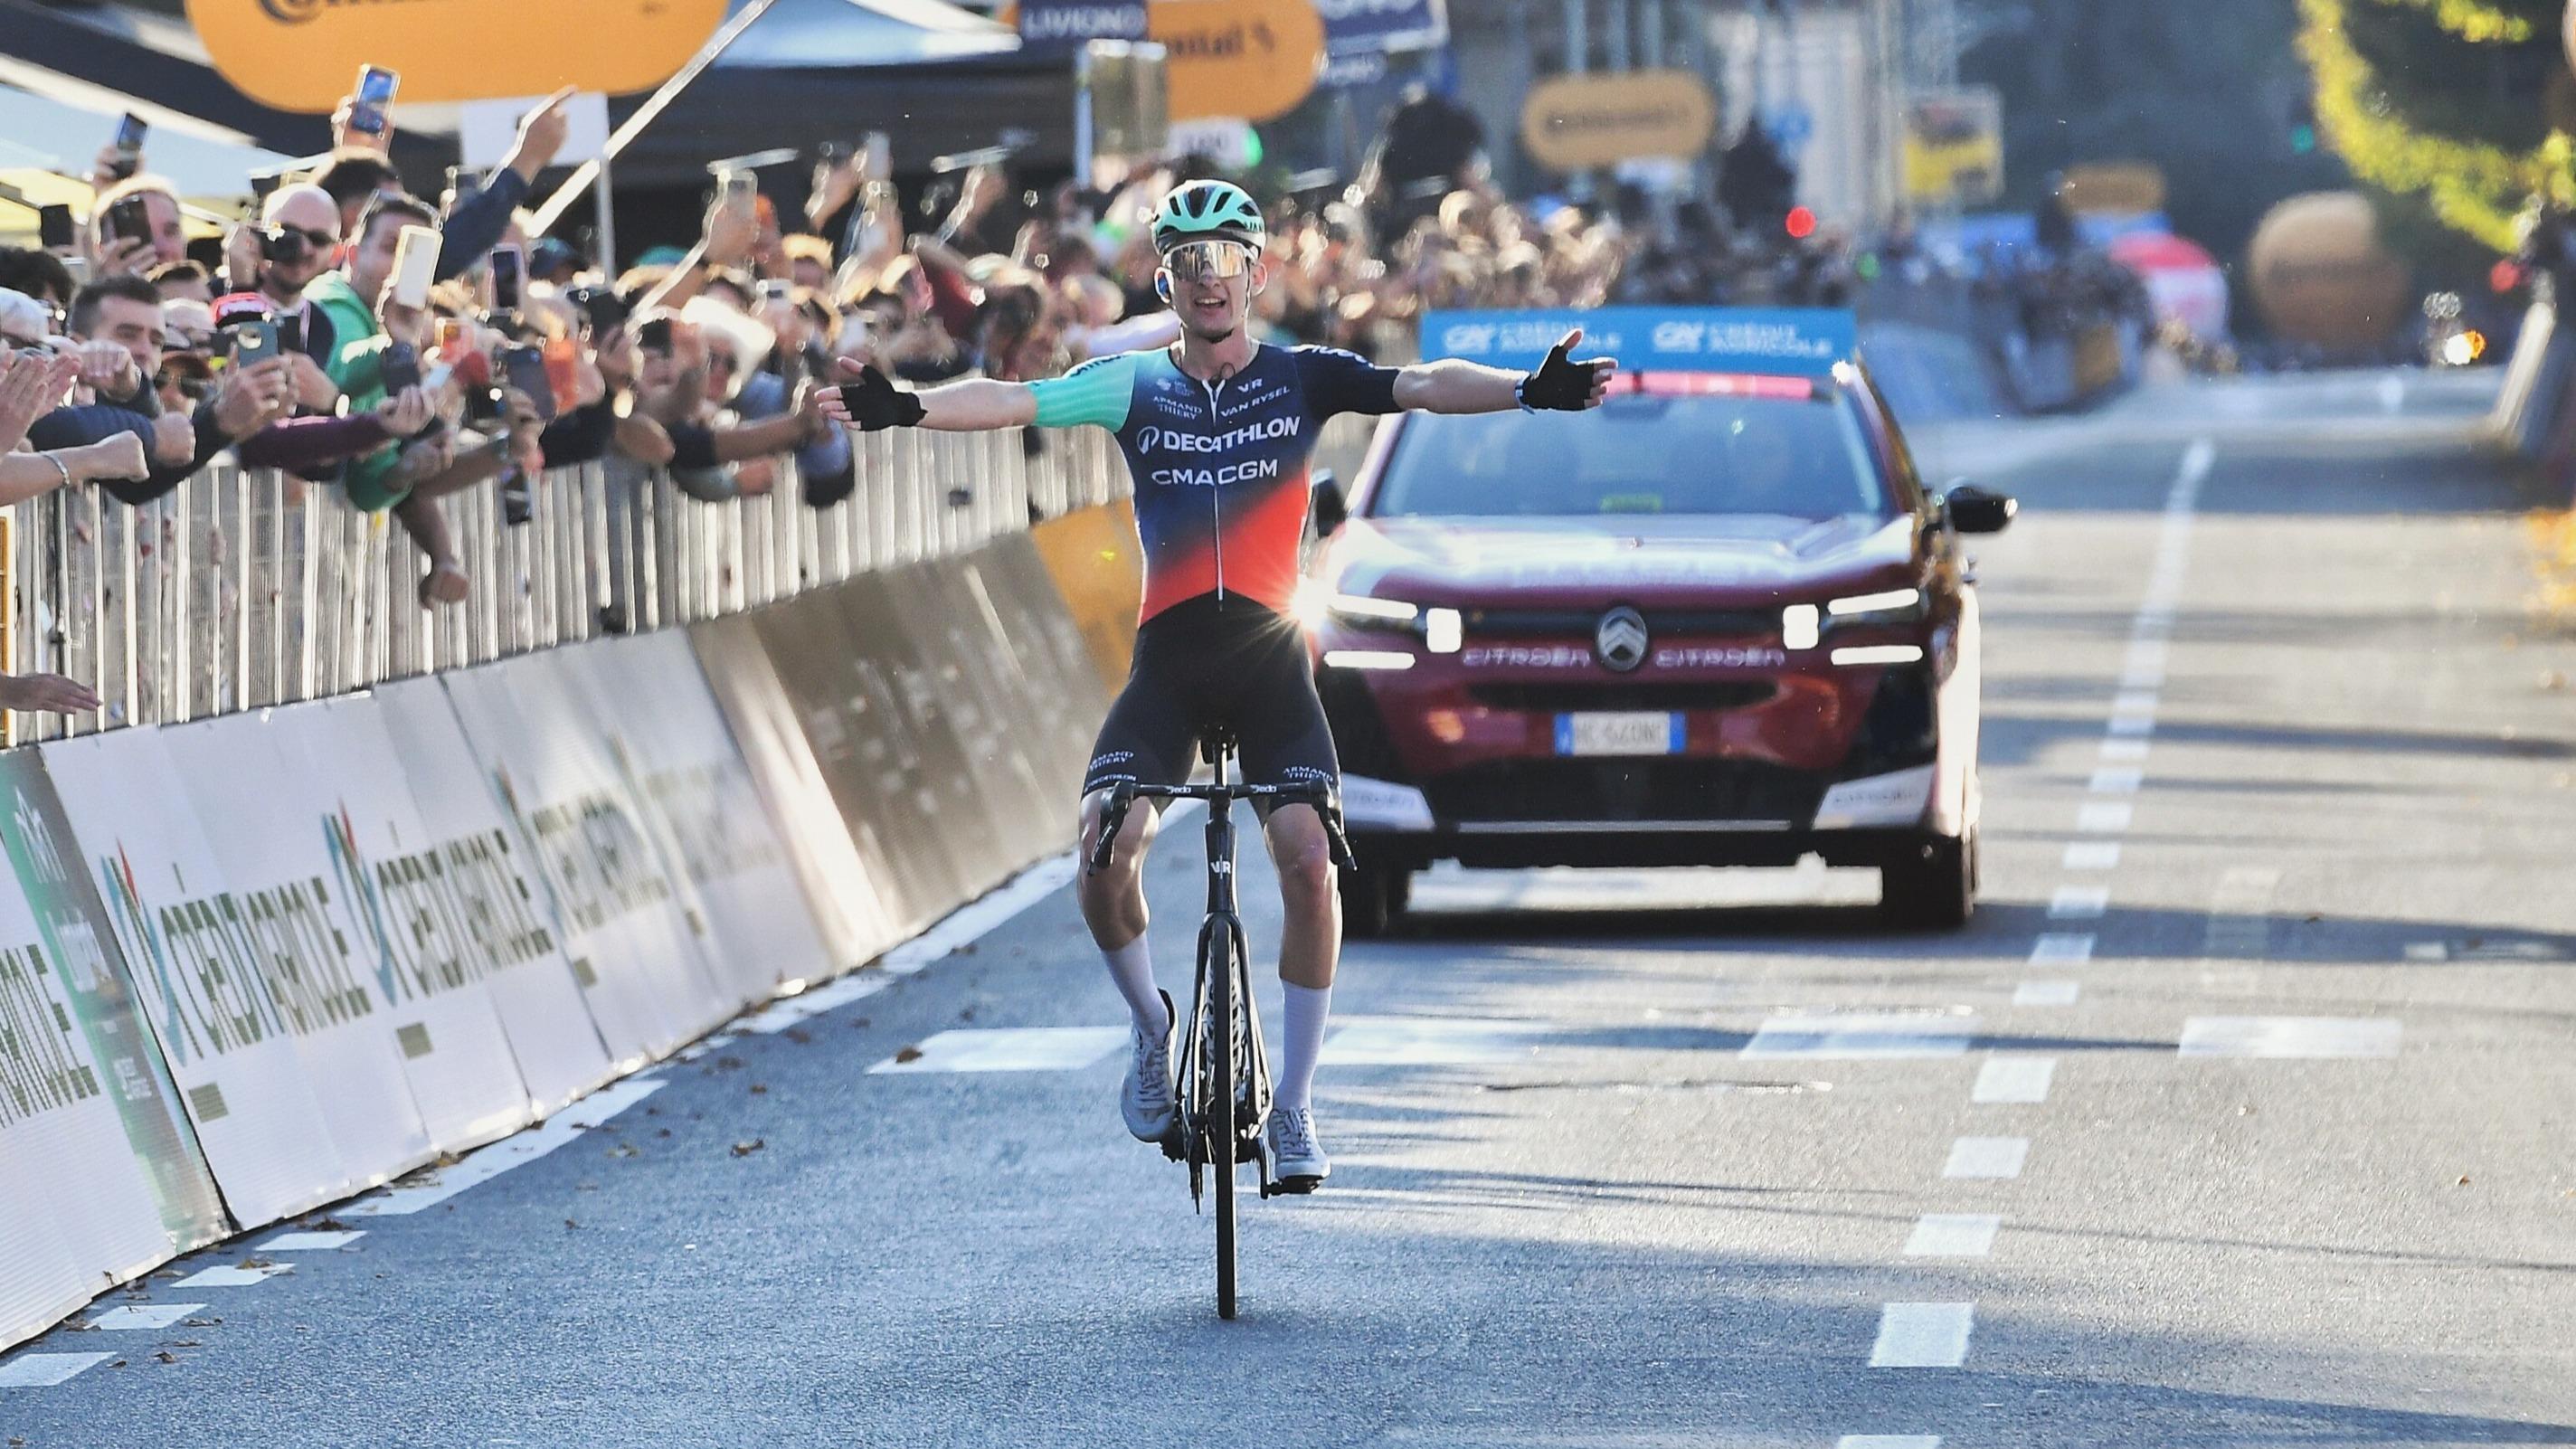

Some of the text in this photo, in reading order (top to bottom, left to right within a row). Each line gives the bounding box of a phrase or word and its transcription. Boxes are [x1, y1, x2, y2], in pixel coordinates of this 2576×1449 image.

[1152, 395, 1203, 414] ARMAND
[1220, 385, 1291, 418] VAN RYSEL
[1163, 416, 1301, 453] DECATHLON
[1283, 766, 1333, 782] ARMAND
